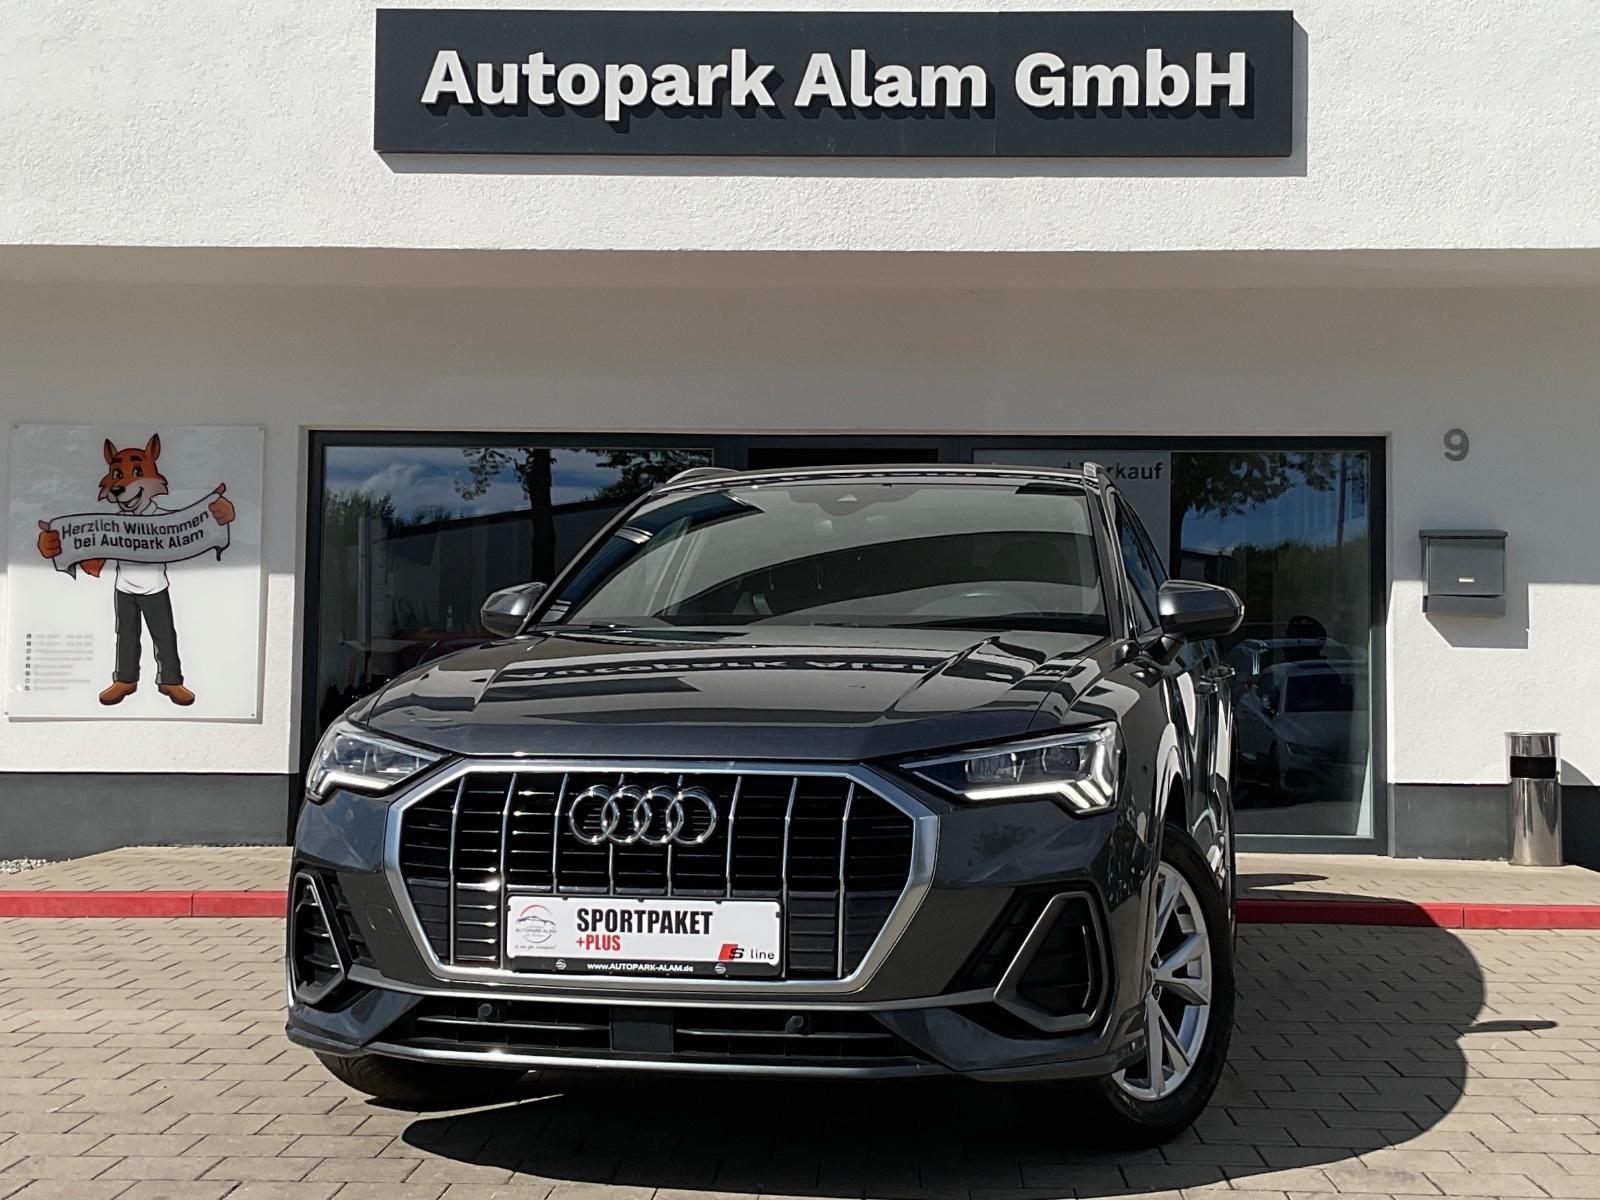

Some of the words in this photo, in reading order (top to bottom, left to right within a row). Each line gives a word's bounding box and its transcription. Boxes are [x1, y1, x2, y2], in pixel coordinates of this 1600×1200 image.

[421, 49, 776, 121] Autopark
[794, 49, 987, 108] Alam
[1014, 49, 1247, 108] GmbH
[1443, 428, 1470, 462] 9
[62, 518, 120, 540] Herzlich
[123, 510, 209, 536] Willkommen
[73, 535, 96, 550] bei
[101, 534, 164, 551] Autopark
[168, 530, 204, 549] Alam
[576, 908, 714, 935] SPORTPAKET
[576, 934, 621, 952] +PLUS
[728, 947, 745, 960] S
[750, 948, 775, 960] line
[587, 962, 694, 972] www.AUTOPARK-ALAM.de
